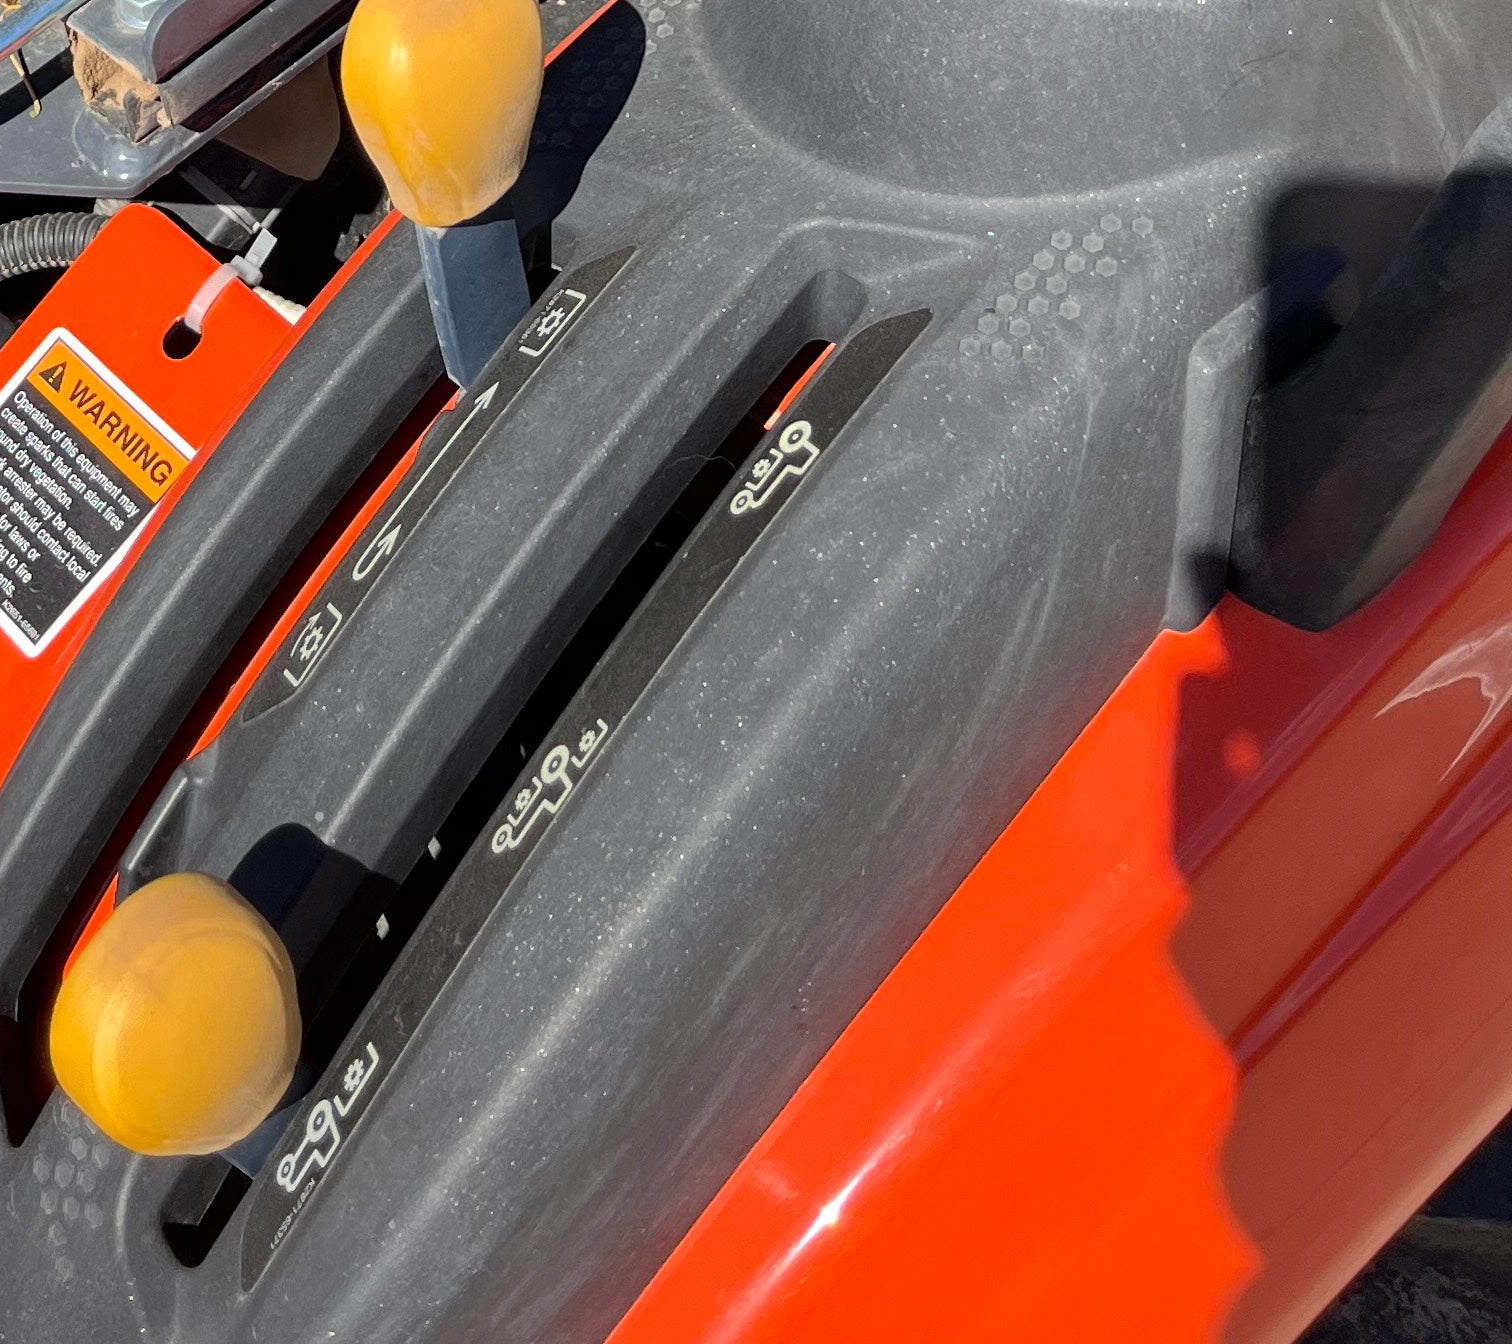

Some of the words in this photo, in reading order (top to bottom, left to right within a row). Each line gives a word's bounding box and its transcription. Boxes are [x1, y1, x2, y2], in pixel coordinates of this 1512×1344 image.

[0, 407, 29, 436] create
[24, 431, 55, 462] sparks
[51, 455, 73, 479] that
[67, 473, 87, 495] can
[83, 489, 108, 514] start
[102, 505, 125, 532] fires
[13, 390, 55, 434] Operation
[51, 429, 67, 443] of
[60, 436, 79, 458] this
[75, 453, 125, 503] equipment
[117, 494, 140, 519] may
[68, 378, 173, 487] WARNING
[3, 466, 39, 501] arrester
[33, 496, 56, 521] may
[51, 512, 67, 531] be
[63, 526, 103, 568] required.
[14, 449, 33, 469] dry
[28, 462, 73, 511] vegetation.
[5, 553, 19, 569] to
[14, 562, 32, 584] fire
[7, 525, 31, 553] laws
[27, 548, 41, 562] or
[9, 501, 43, 533] should
[36, 528, 71, 564] contact
[65, 555, 92, 583] local
